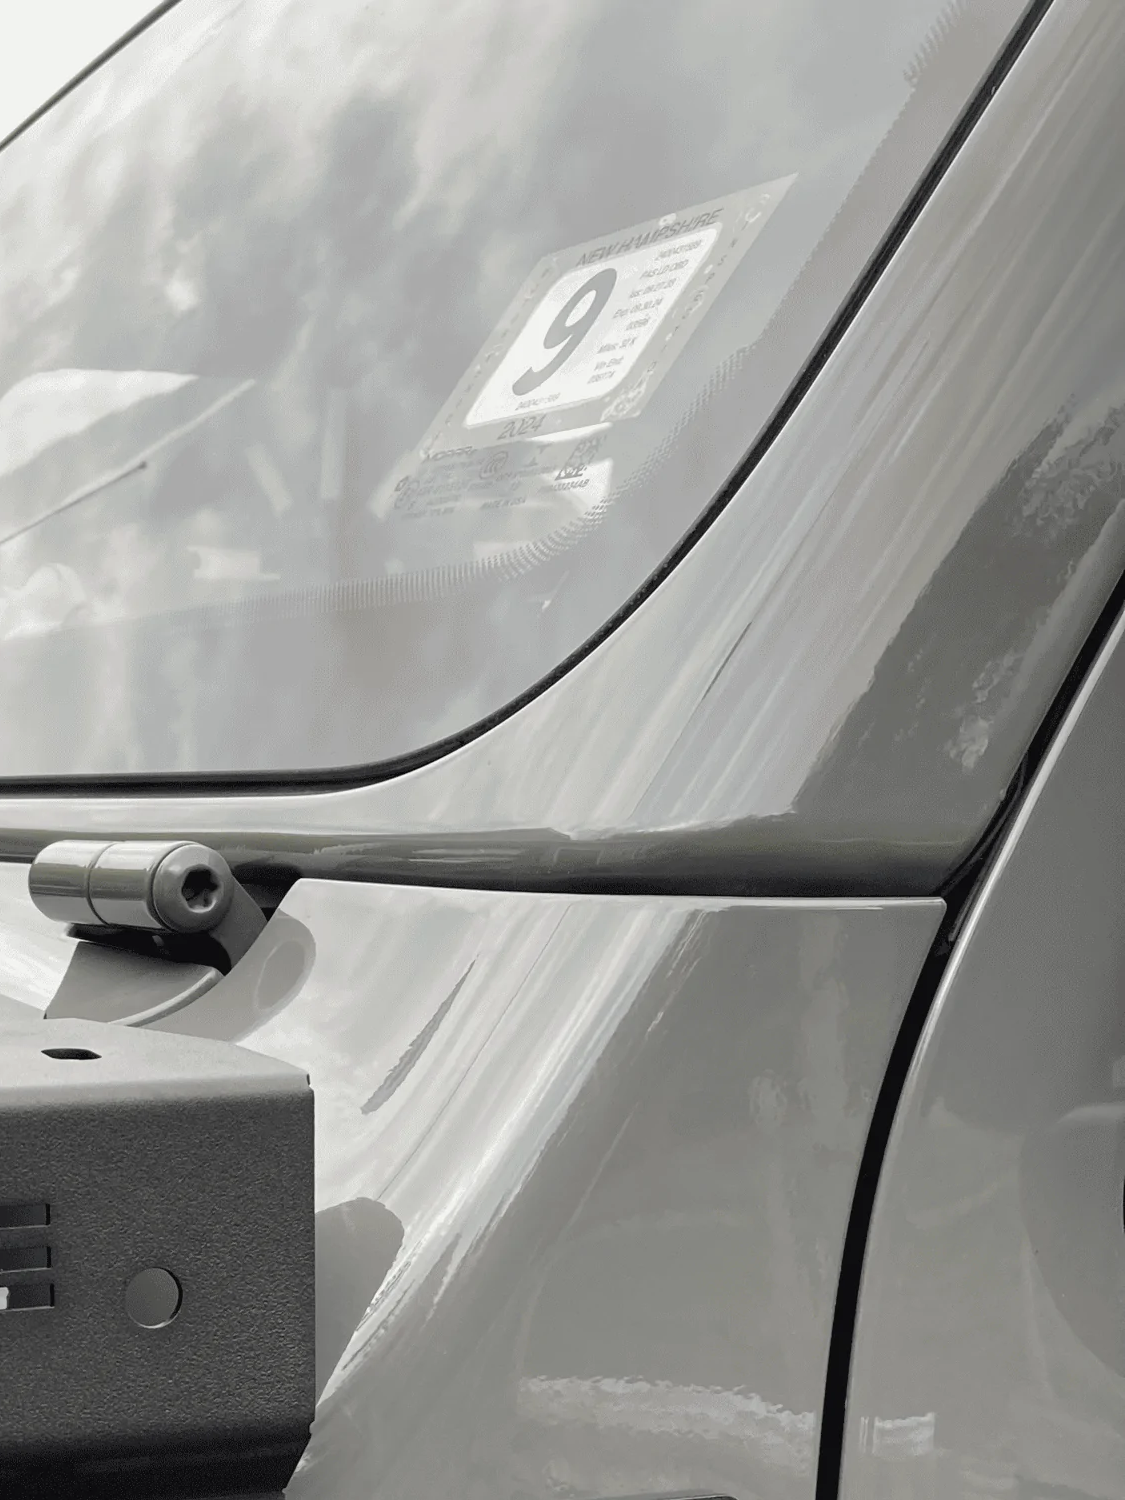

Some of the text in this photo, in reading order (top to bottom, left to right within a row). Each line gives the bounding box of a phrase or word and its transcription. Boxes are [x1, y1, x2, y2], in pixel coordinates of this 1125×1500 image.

[576, 245, 617, 266] NEW
[617, 208, 723, 253] HAMPSHIRE
[512, 268, 617, 395] 9
[496, 414, 546, 440] 2024
